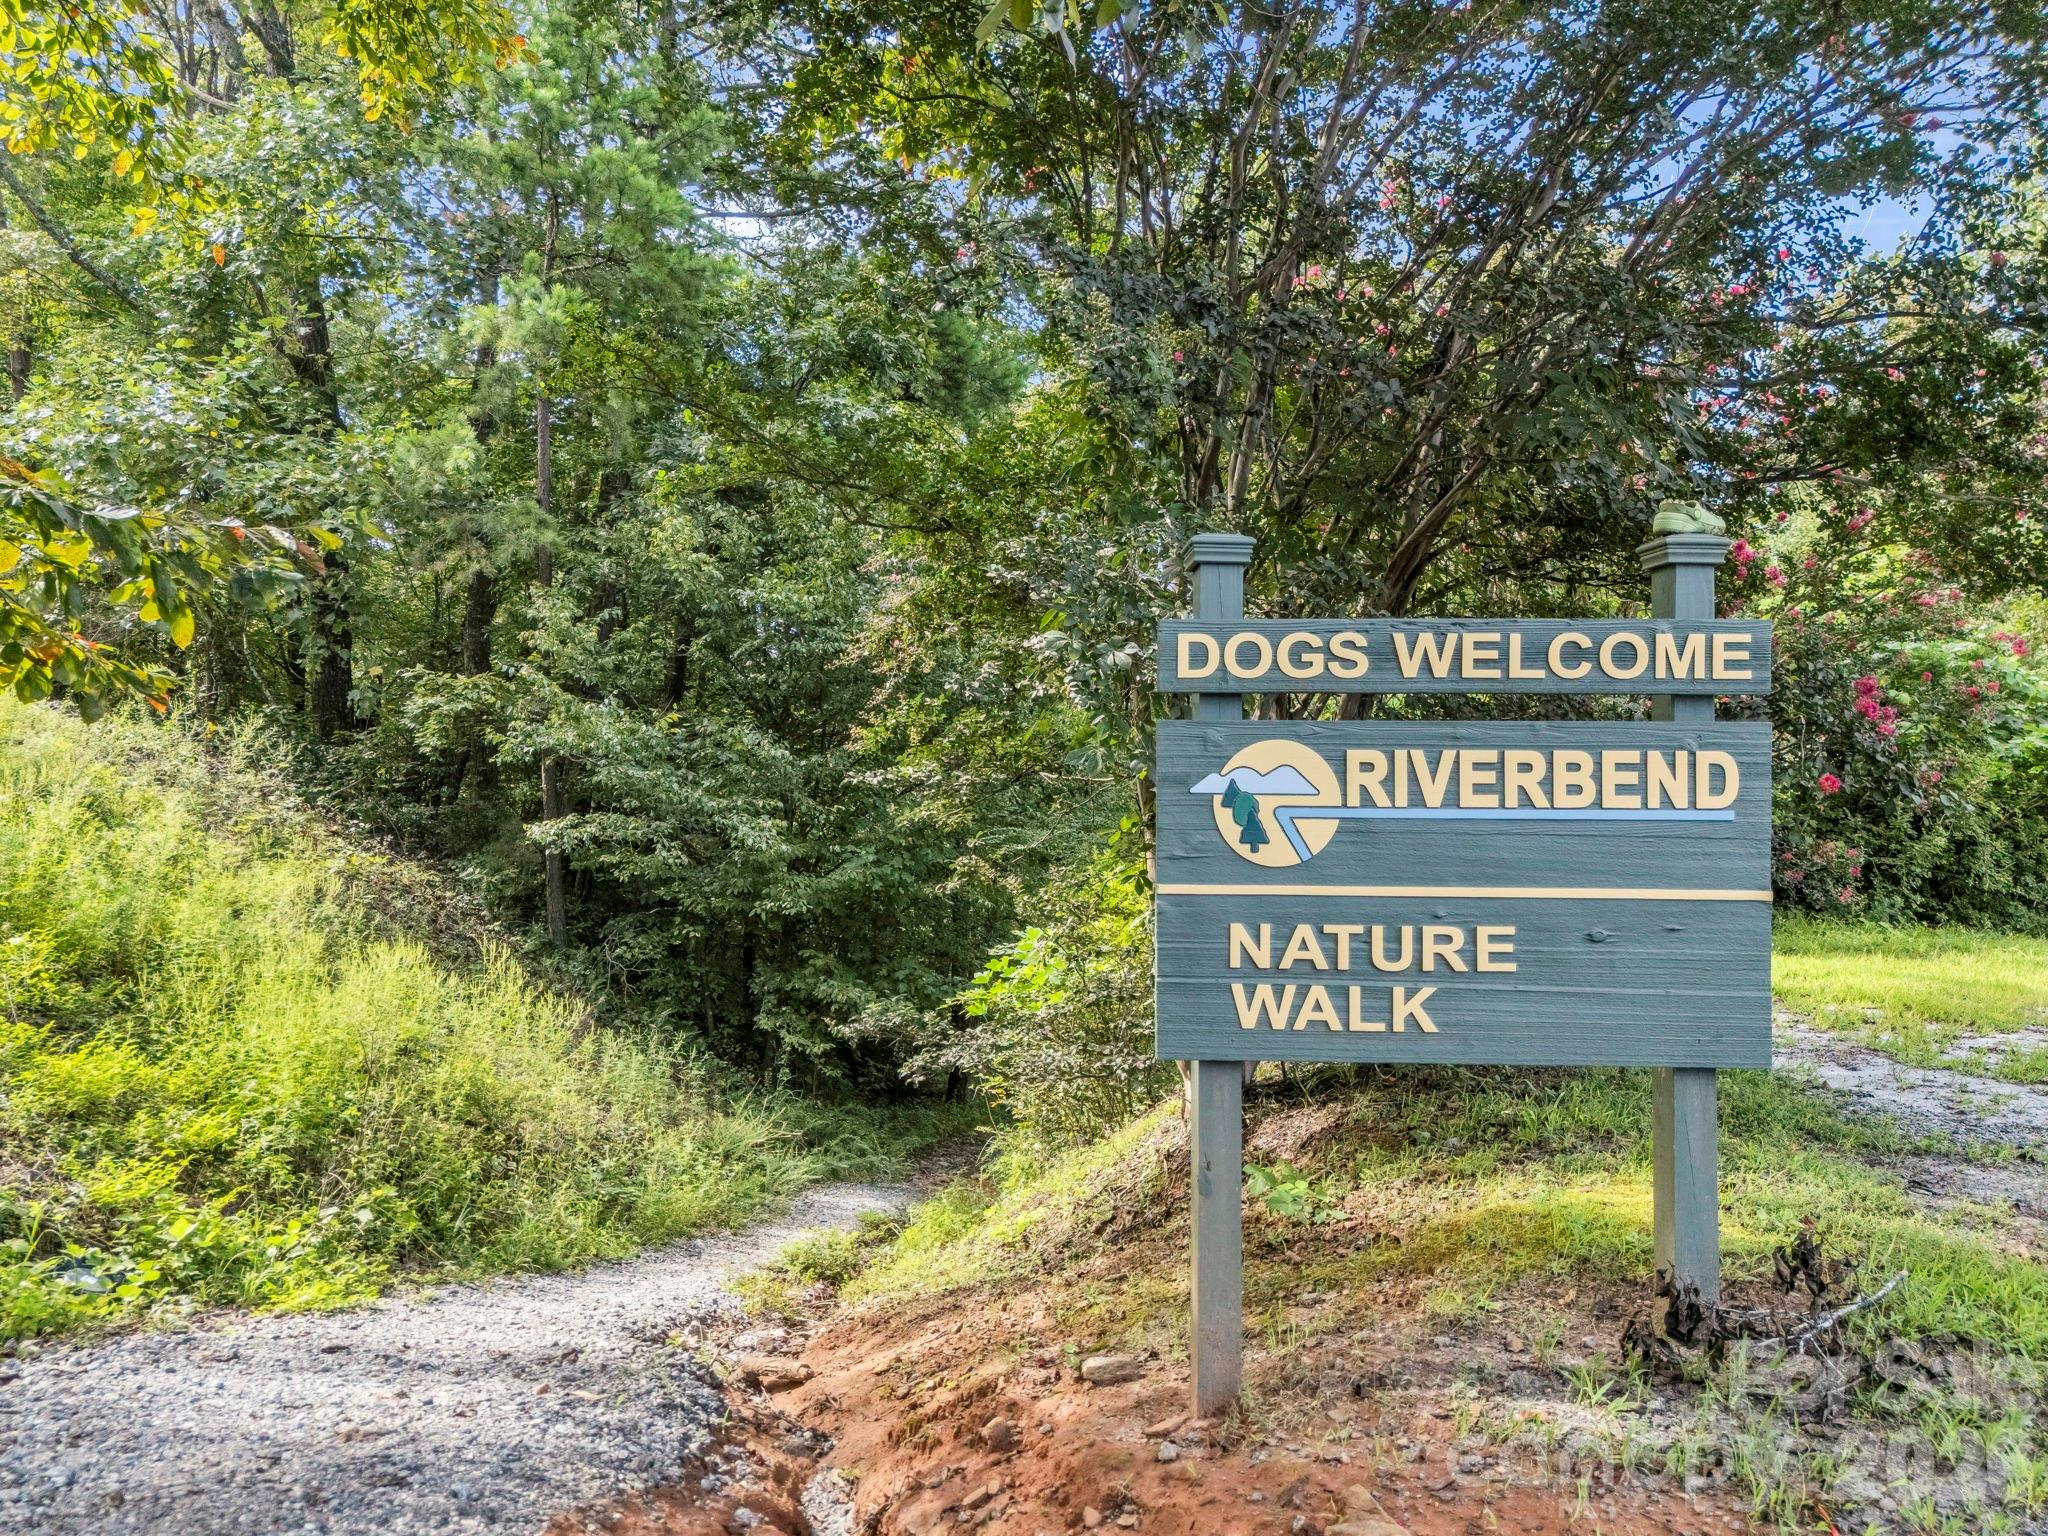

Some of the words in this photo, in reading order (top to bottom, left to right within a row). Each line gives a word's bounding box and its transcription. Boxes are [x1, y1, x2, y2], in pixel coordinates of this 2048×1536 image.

[1177, 632, 1369, 679] DOGS
[1392, 633, 1753, 680] WELCOME
[1345, 749, 1740, 810] RIVERBEND
[1229, 923, 1518, 972] NATURE
[1231, 984, 1439, 1034] WALK
